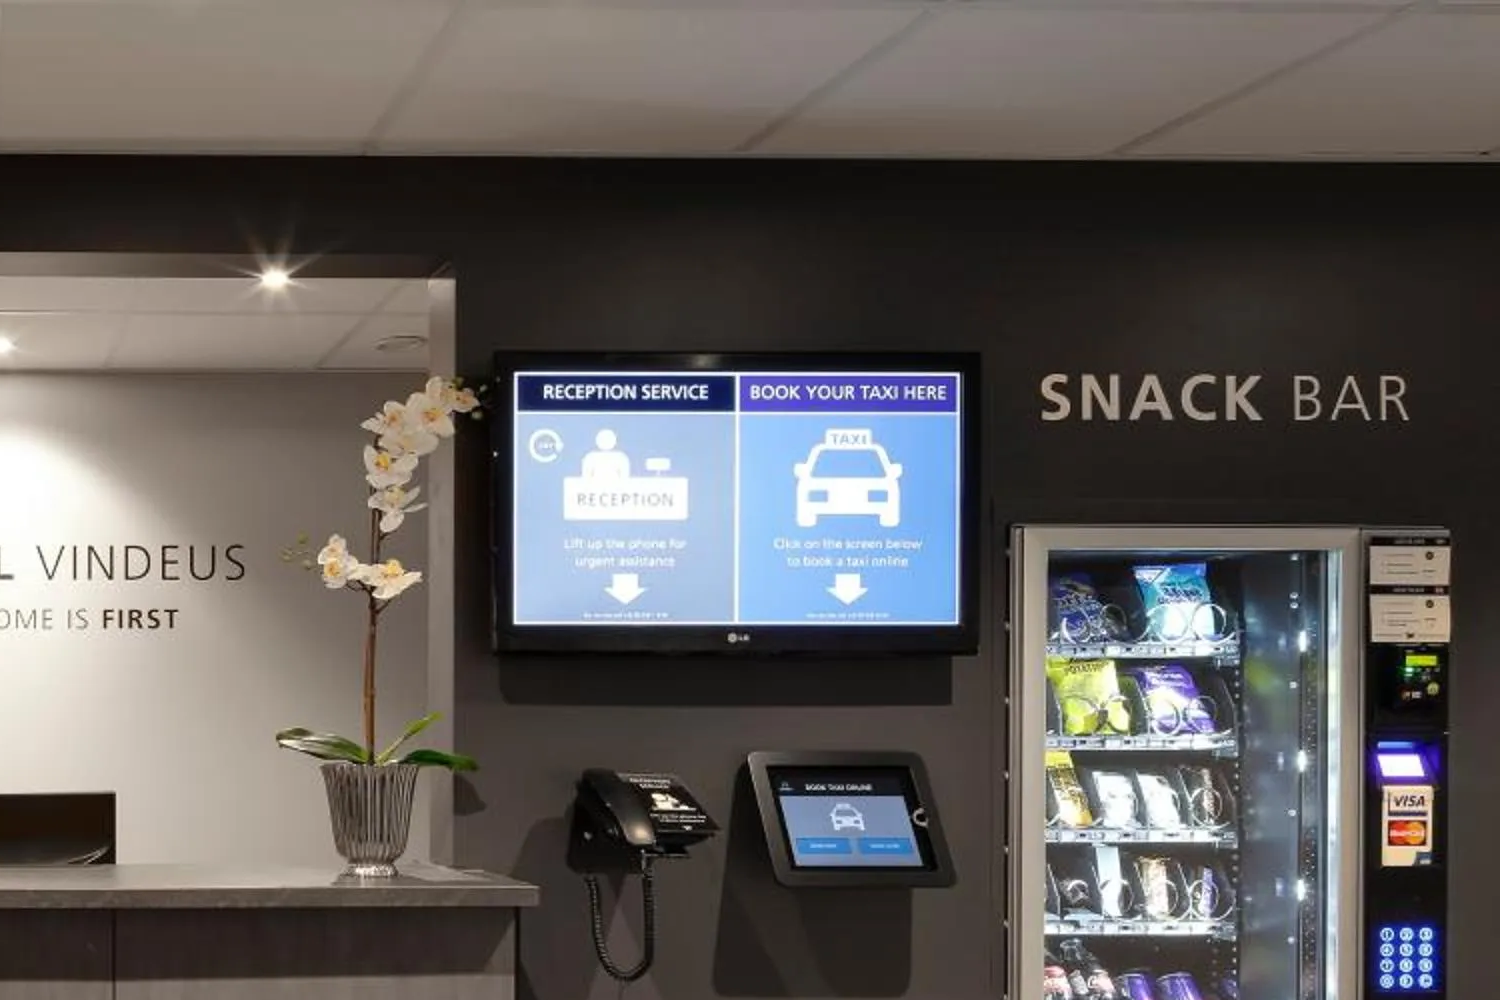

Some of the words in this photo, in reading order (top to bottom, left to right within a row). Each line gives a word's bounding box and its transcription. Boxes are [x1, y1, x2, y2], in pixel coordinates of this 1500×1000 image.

[543, 384, 637, 400] RECEPTION
[641, 384, 709, 400] SERVICE
[750, 384, 800, 401] BOOK
[806, 384, 856, 401] YOUR
[860, 384, 899, 401] TAXI
[903, 384, 947, 401] HERE
[1040, 373, 1263, 422] SNACK
[1293, 375, 1410, 421] BAR
[829, 432, 869, 446] TAXI
[577, 492, 674, 508] RECEPTION
[564, 538, 583, 549] Lift
[587, 540, 602, 551] up
[606, 538, 625, 549] the
[629, 538, 667, 551] phone
[669, 538, 687, 549] for
[773, 538, 800, 549] Click
[804, 540, 820, 549] on
[823, 538, 843, 549] the
[846, 540, 883, 549] screen
[885, 538, 922, 549] below
[36, 545, 246, 581] VINDEUS
[574, 557, 615, 569] urgent
[619, 556, 676, 567] assistance
[787, 557, 800, 567] to
[803, 556, 832, 567] book
[846, 556, 869, 567] taxi
[66, 608, 90, 631] IS
[102, 608, 180, 630] FIRST
[1393, 795, 1425, 807] VISA
